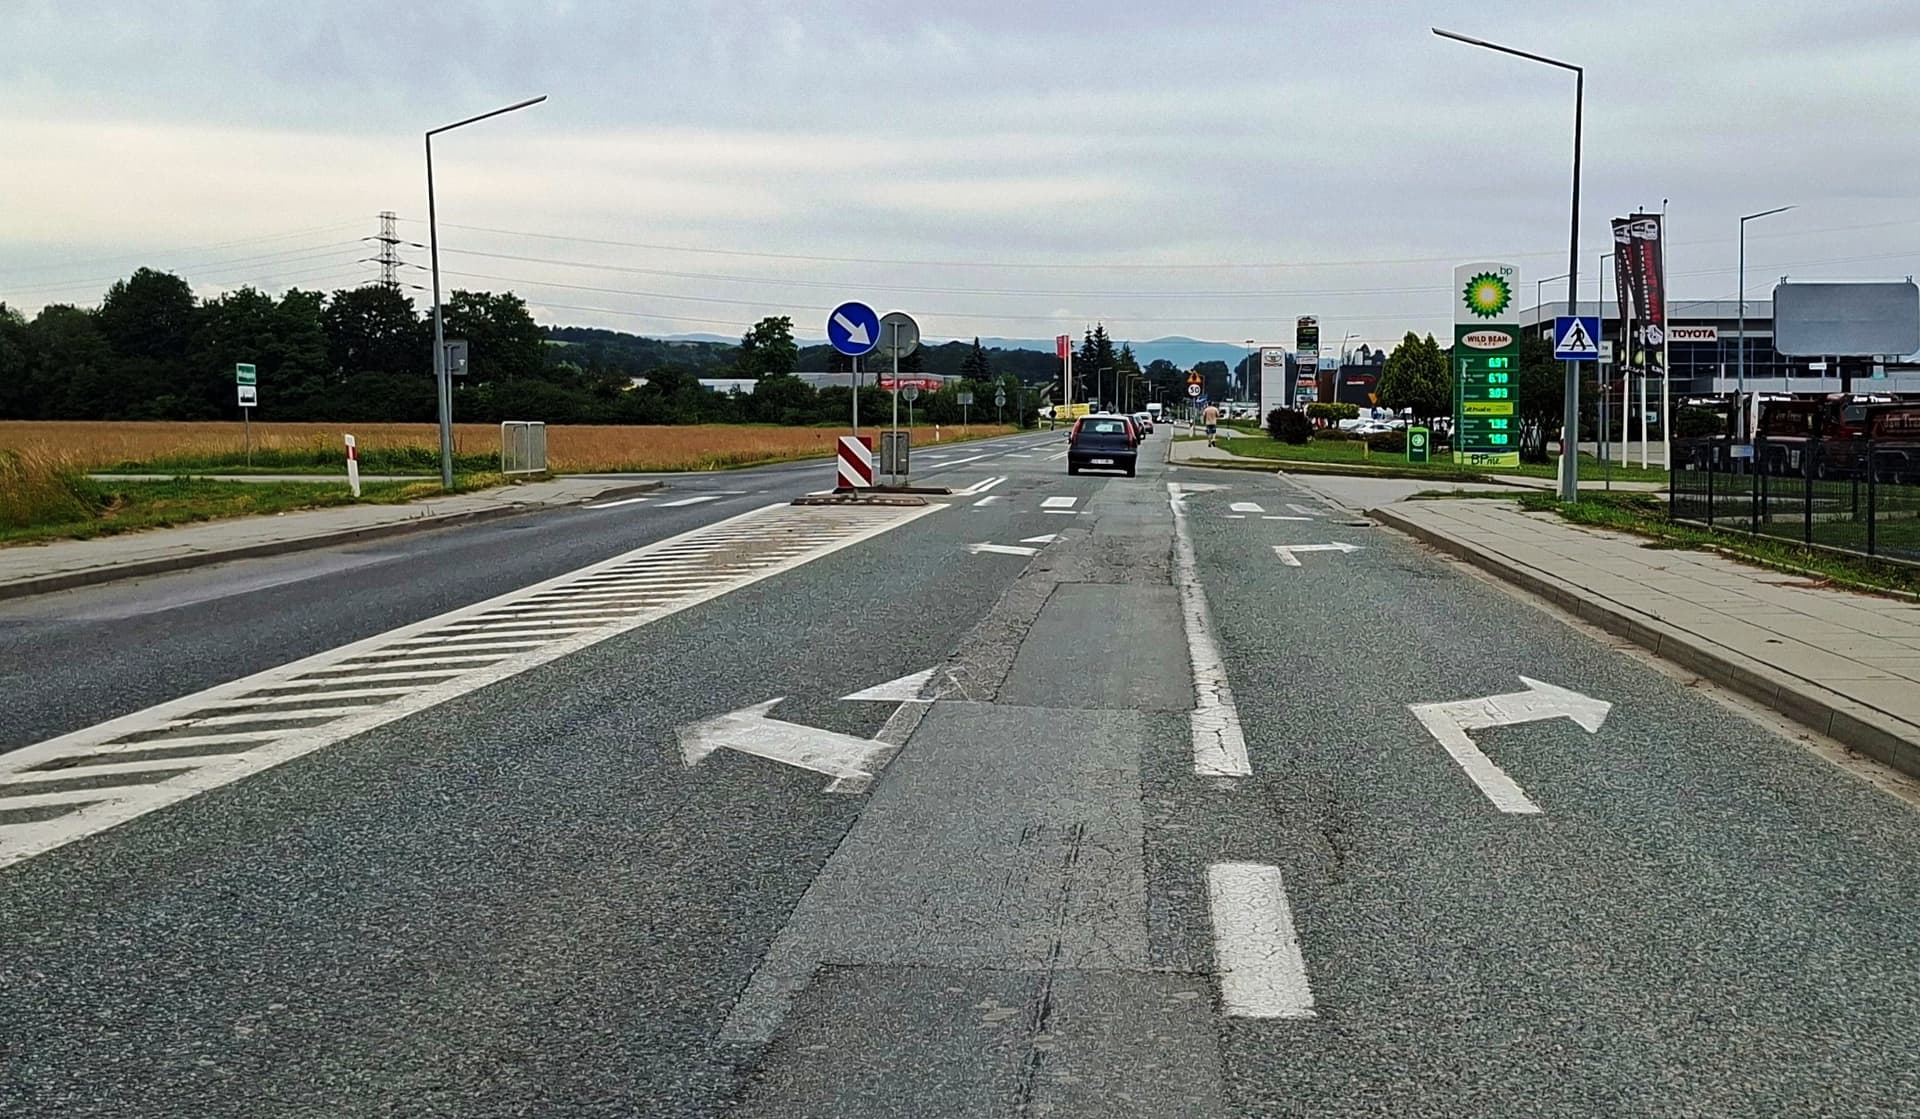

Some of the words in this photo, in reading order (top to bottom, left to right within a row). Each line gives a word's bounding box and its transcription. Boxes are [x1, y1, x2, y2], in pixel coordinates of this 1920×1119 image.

[1500, 267, 1513, 276] bp
[1672, 329, 1716, 338] TOYOTA
[1189, 386, 1200, 394] 50
